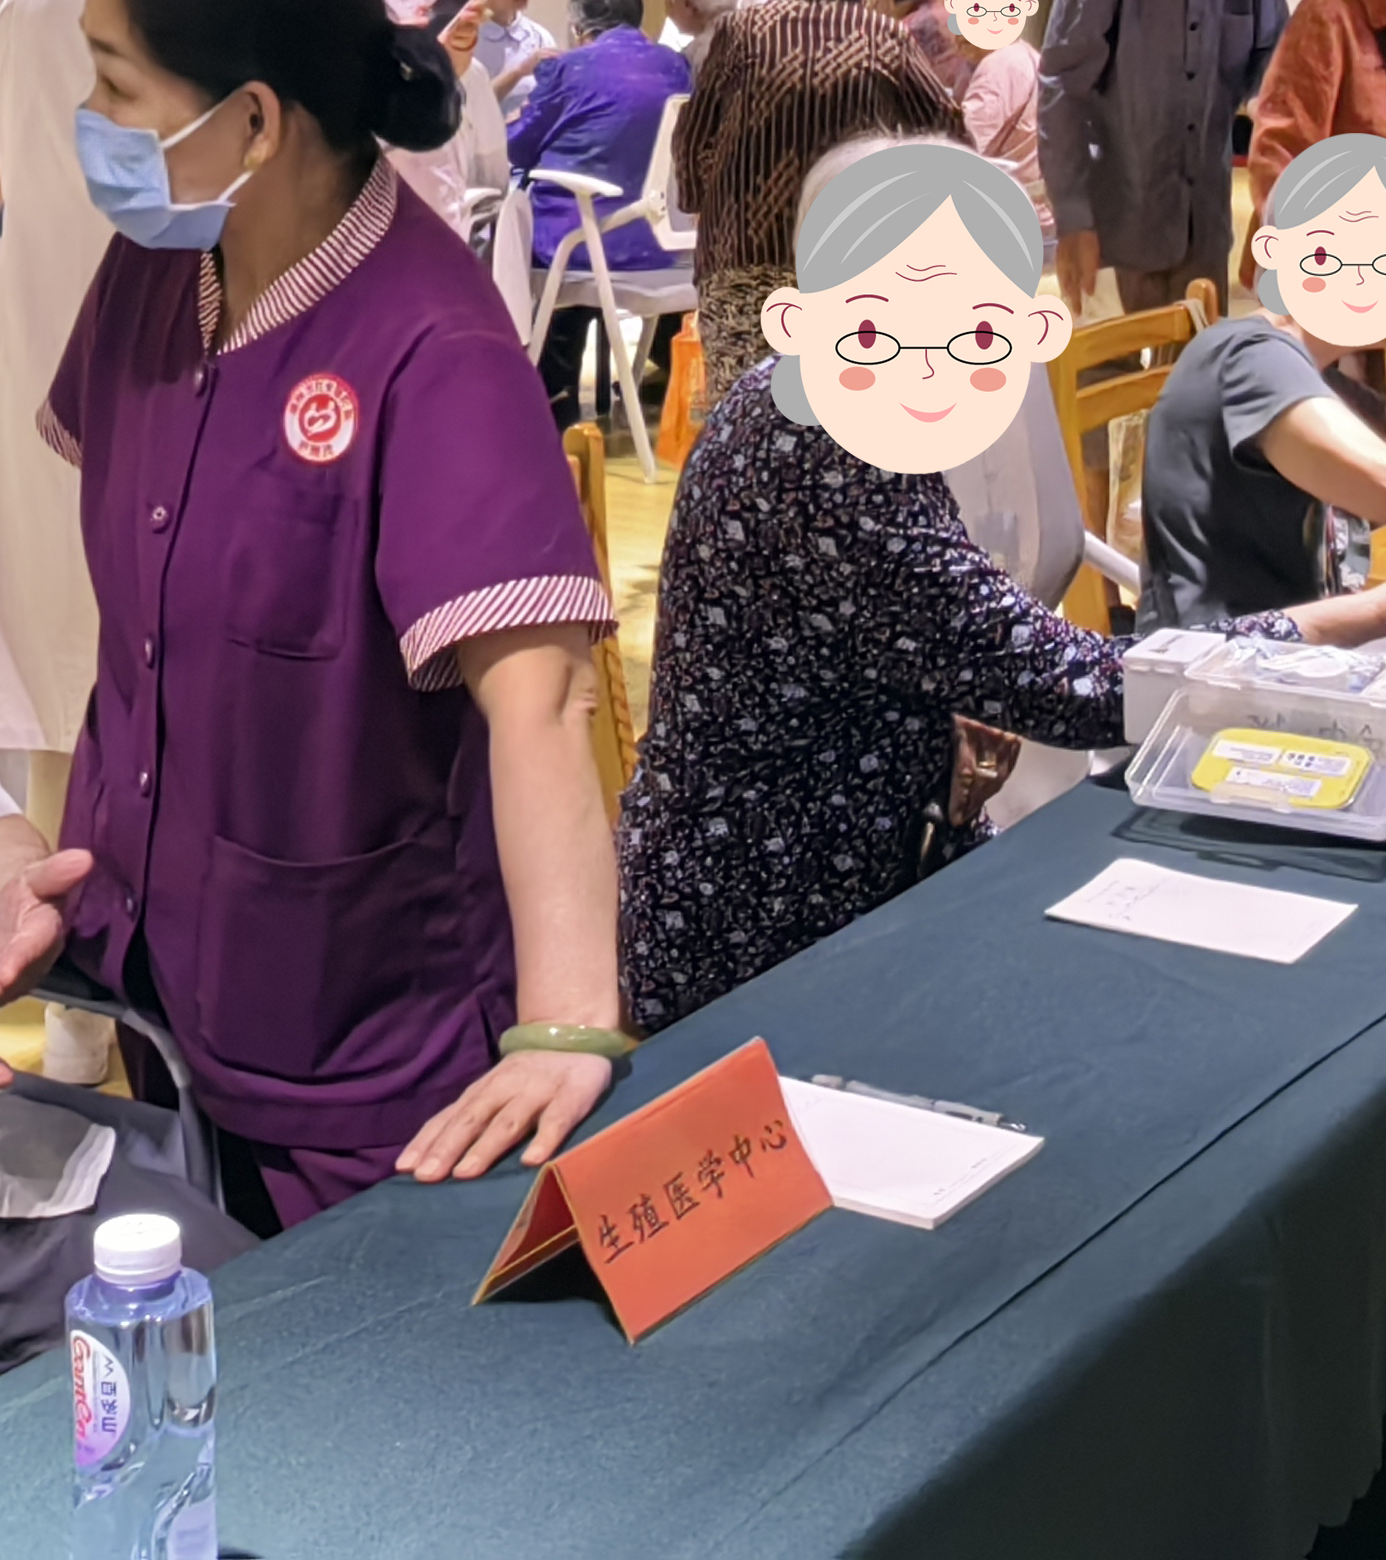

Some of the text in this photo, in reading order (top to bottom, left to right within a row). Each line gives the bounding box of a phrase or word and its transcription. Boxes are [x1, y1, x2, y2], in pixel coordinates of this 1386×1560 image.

[598, 1119, 788, 1265] 生殖医学中心
[100, 1380, 119, 1435] 百岁山
